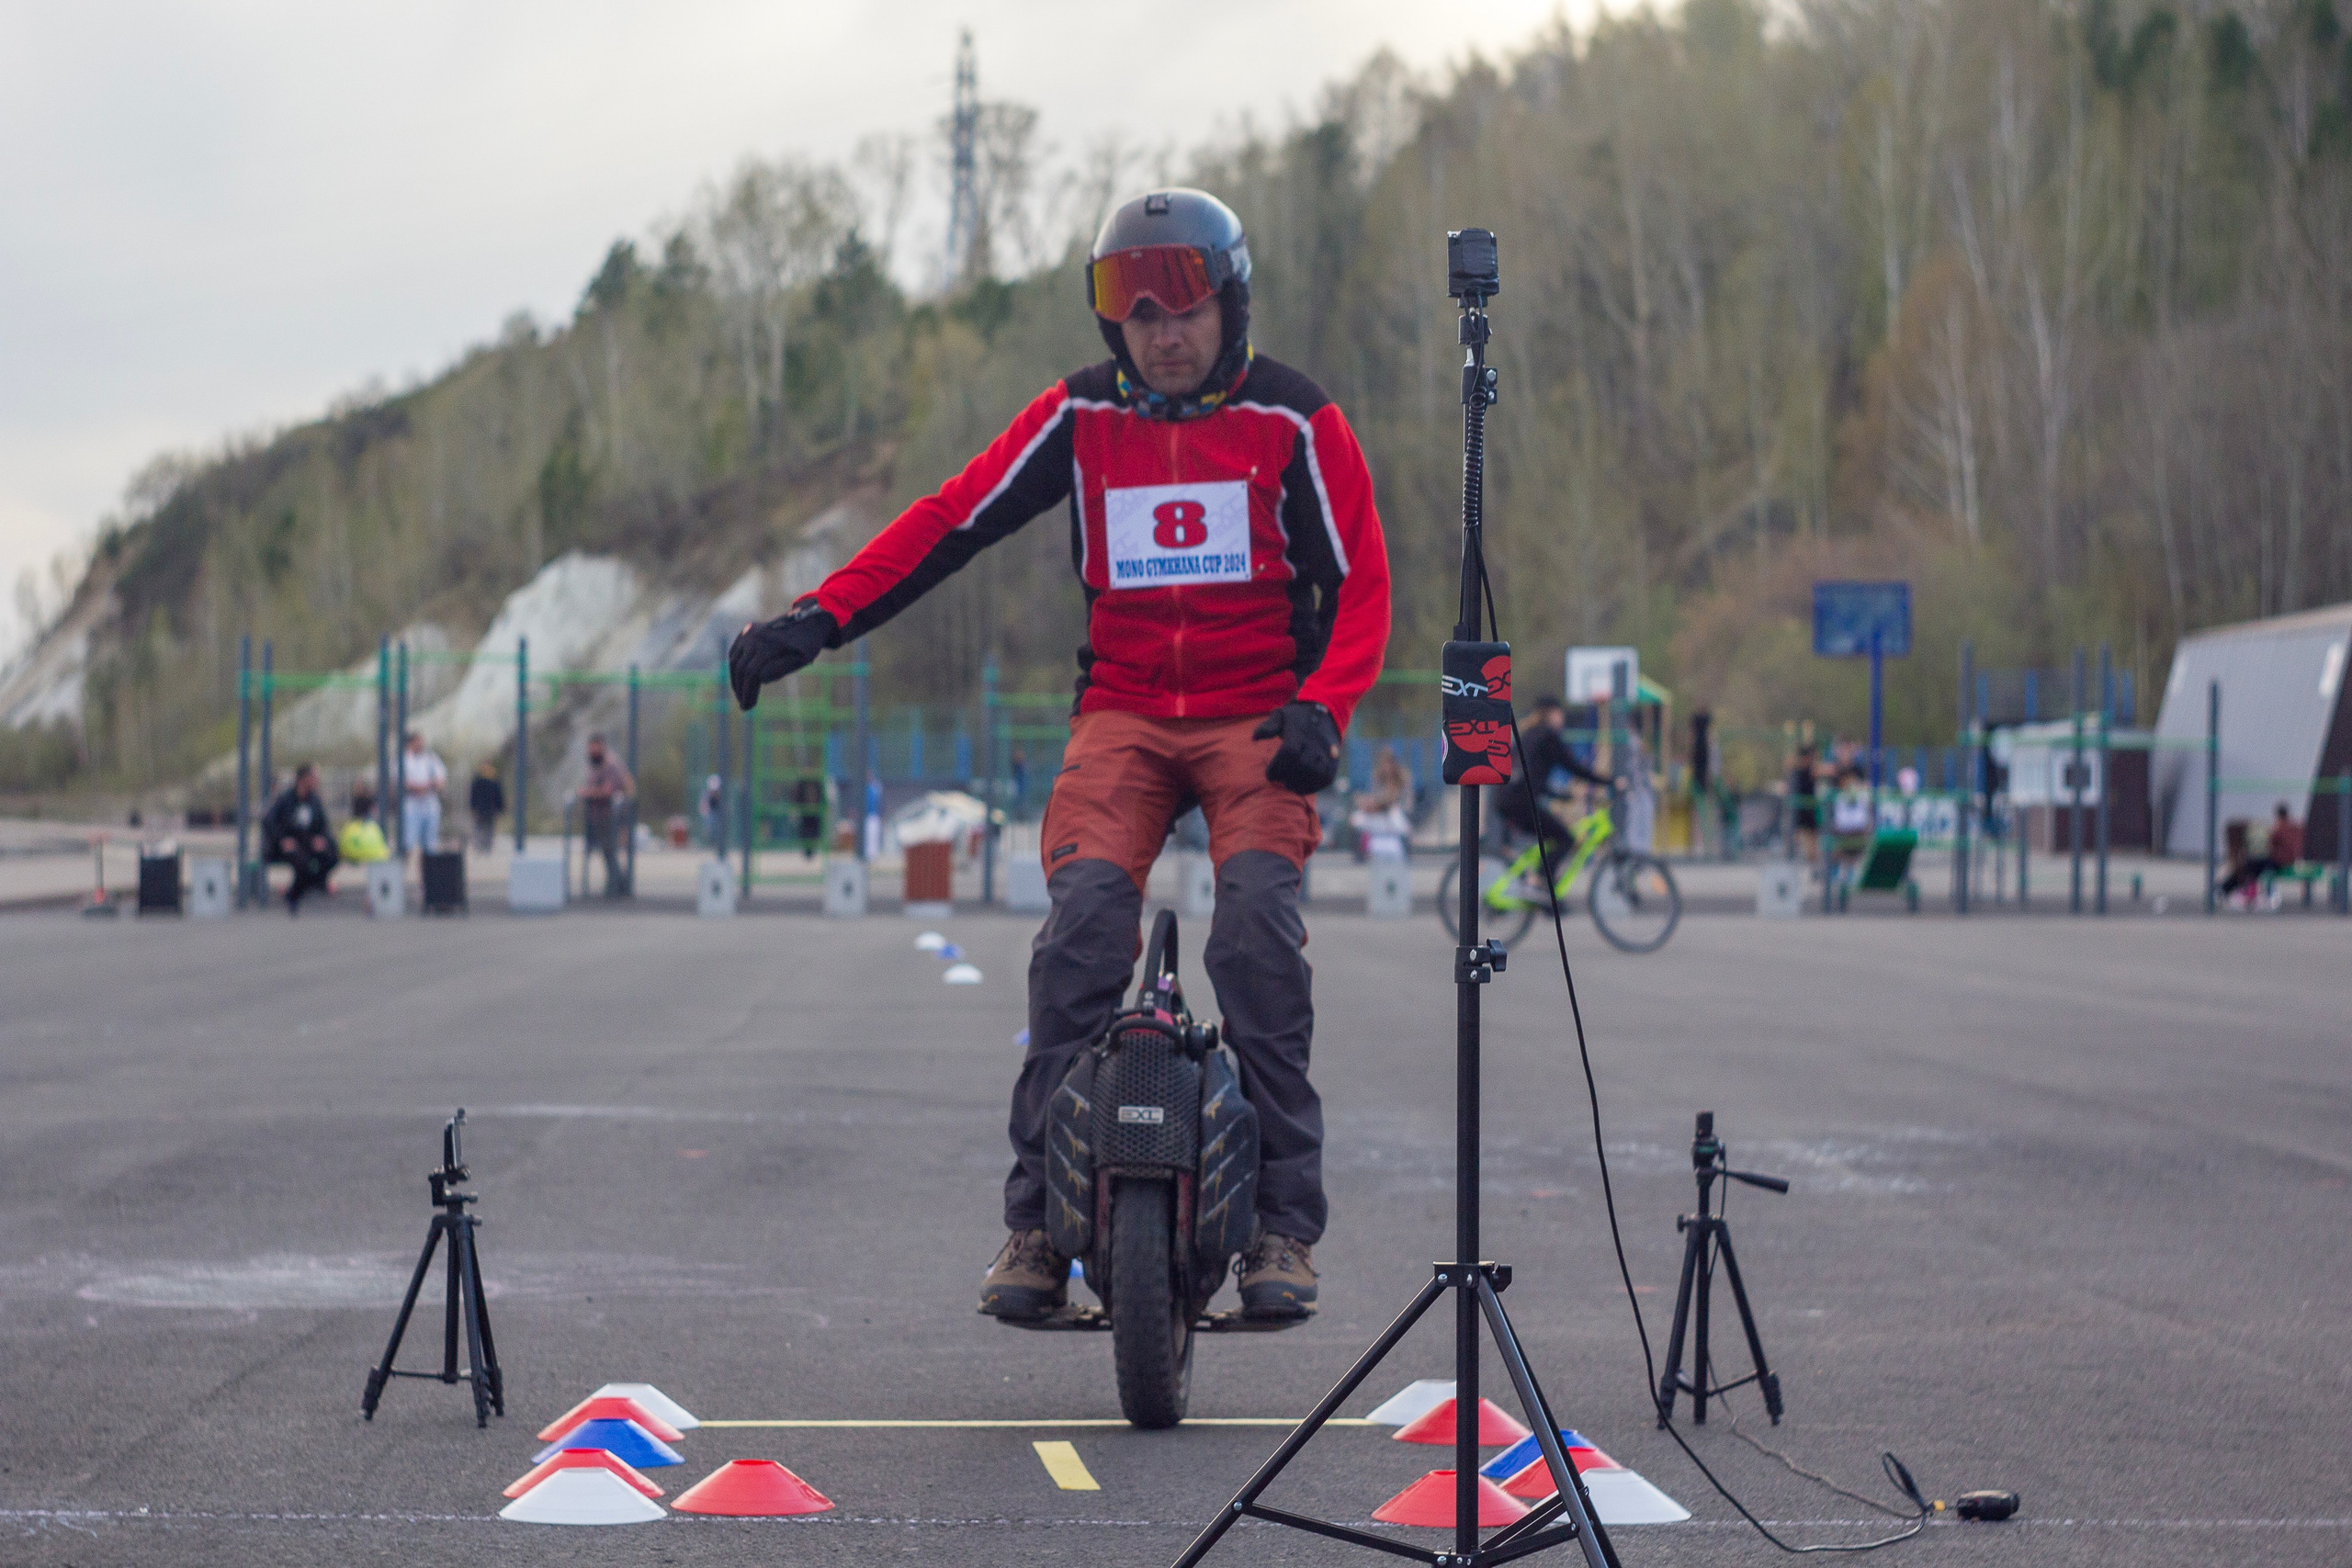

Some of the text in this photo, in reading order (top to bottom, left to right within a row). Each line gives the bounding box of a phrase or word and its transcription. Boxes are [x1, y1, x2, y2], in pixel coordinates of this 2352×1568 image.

[1153, 500, 1208, 549] 8
[1116, 558, 1145, 579] MONO
[1202, 554, 1222, 574] CUP
